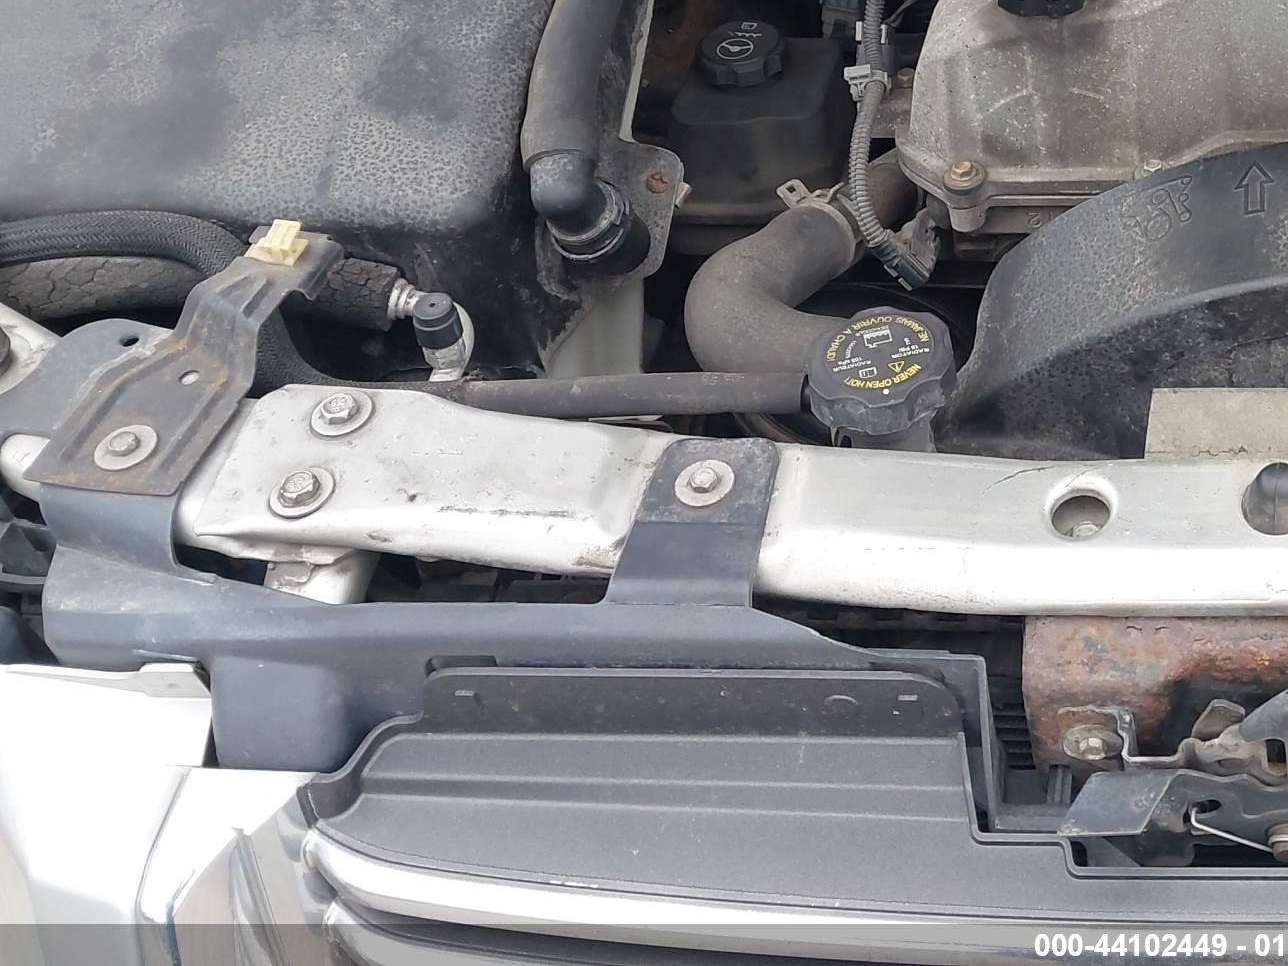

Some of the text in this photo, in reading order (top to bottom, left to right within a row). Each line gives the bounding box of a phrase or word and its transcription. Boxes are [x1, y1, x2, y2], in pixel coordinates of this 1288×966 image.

[851, 316, 892, 330] OUVRIR
[891, 347, 930, 359] RADIATOR
[832, 359, 871, 372] RADIATEUR
[893, 363, 922, 384] NEVER
[865, 377, 892, 389] OPEN
